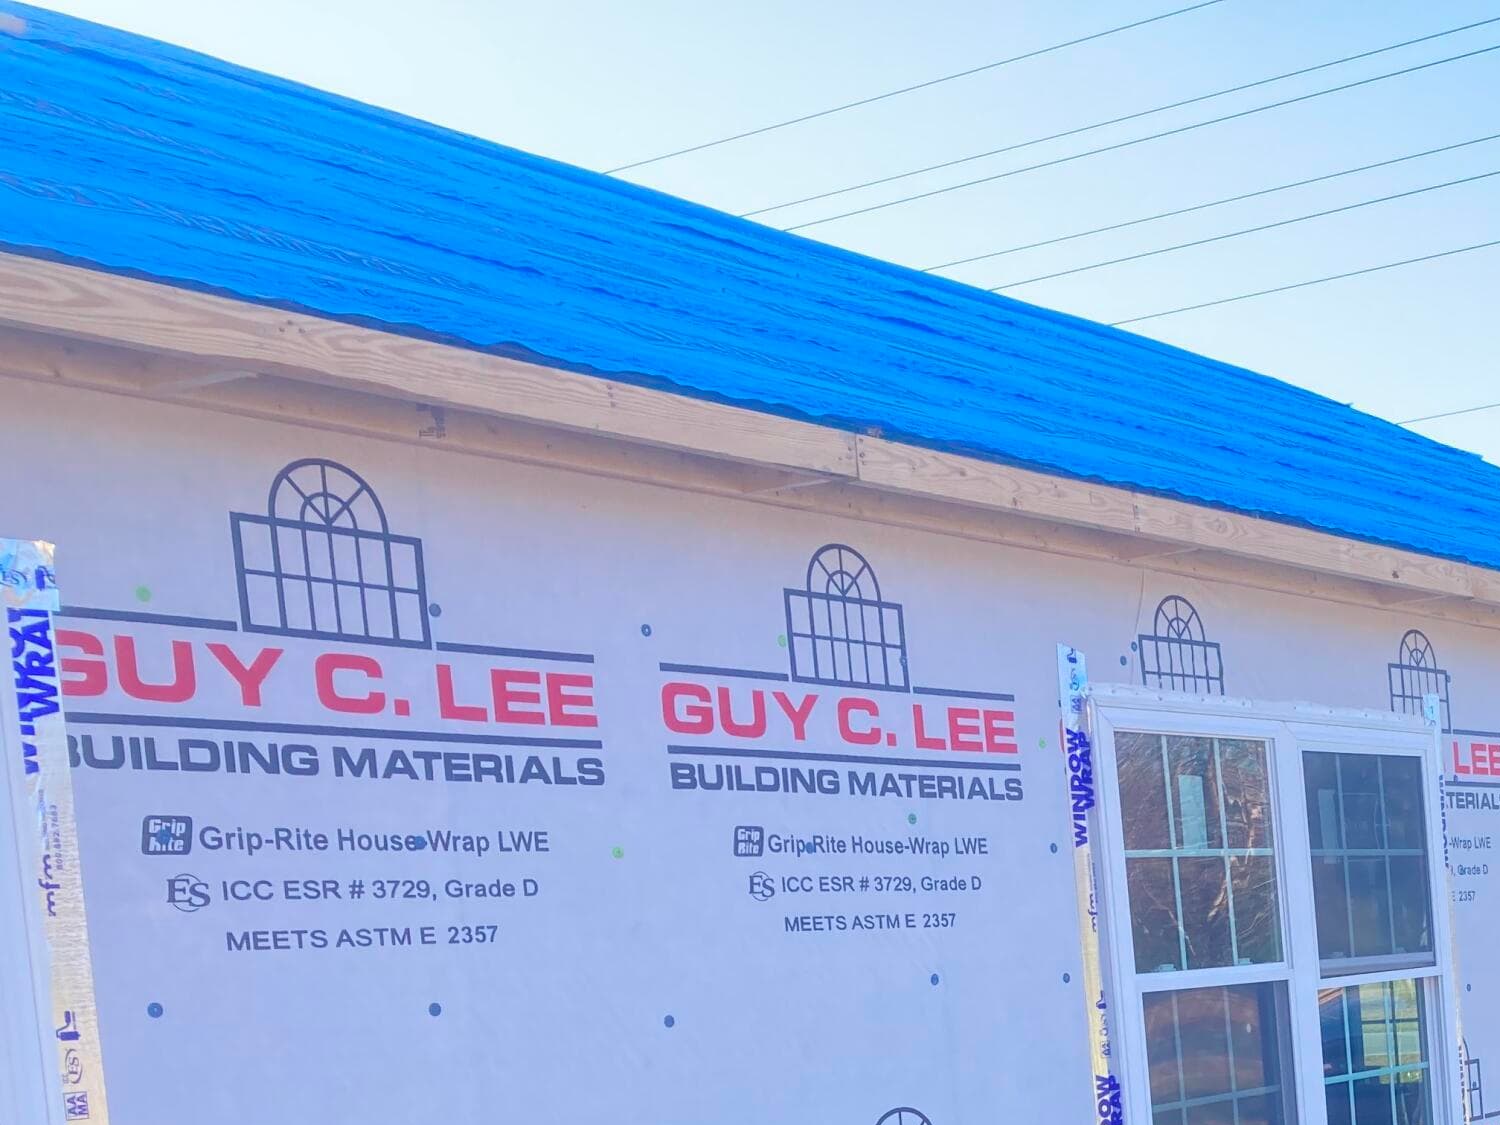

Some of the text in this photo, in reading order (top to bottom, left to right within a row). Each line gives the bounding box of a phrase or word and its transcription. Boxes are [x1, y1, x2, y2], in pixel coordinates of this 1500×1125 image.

[55, 630, 598, 727] GUY C. LEE
[661, 682, 1018, 754] GUY C. LEE
[334, 746, 605, 786] MATERIALS
[1077, 731, 1095, 810] WRAP
[670, 762, 1023, 801] BUILDING MATERIALS
[1066, 728, 1088, 848] WINDOW
[199, 826, 549, 855] Grip-Rite HouseWrap LWE
[768, 834, 988, 858] GripRite House-Wrap LWE
[1474, 837, 1491, 849] LWE
[1483, 864, 1488, 875] D
[222, 880, 274, 902] ICC
[284, 879, 341, 901] ESR
[349, 880, 365, 899] #
[372, 878, 437, 902] 3729,
[445, 880, 515, 899] Grade
[523, 879, 539, 898] D
[781, 876, 813, 893] ICC
[819, 876, 855, 893] ESR
[860, 877, 869, 890] #
[874, 876, 917, 895] 3729,
[920, 876, 967, 891] Grade
[971, 876, 982, 891] D
[1459, 891, 1476, 902] 2357
[784, 912, 957, 933] MEETS ASTM E 2357
[226, 924, 499, 952] MEETS ASTM E 2357
